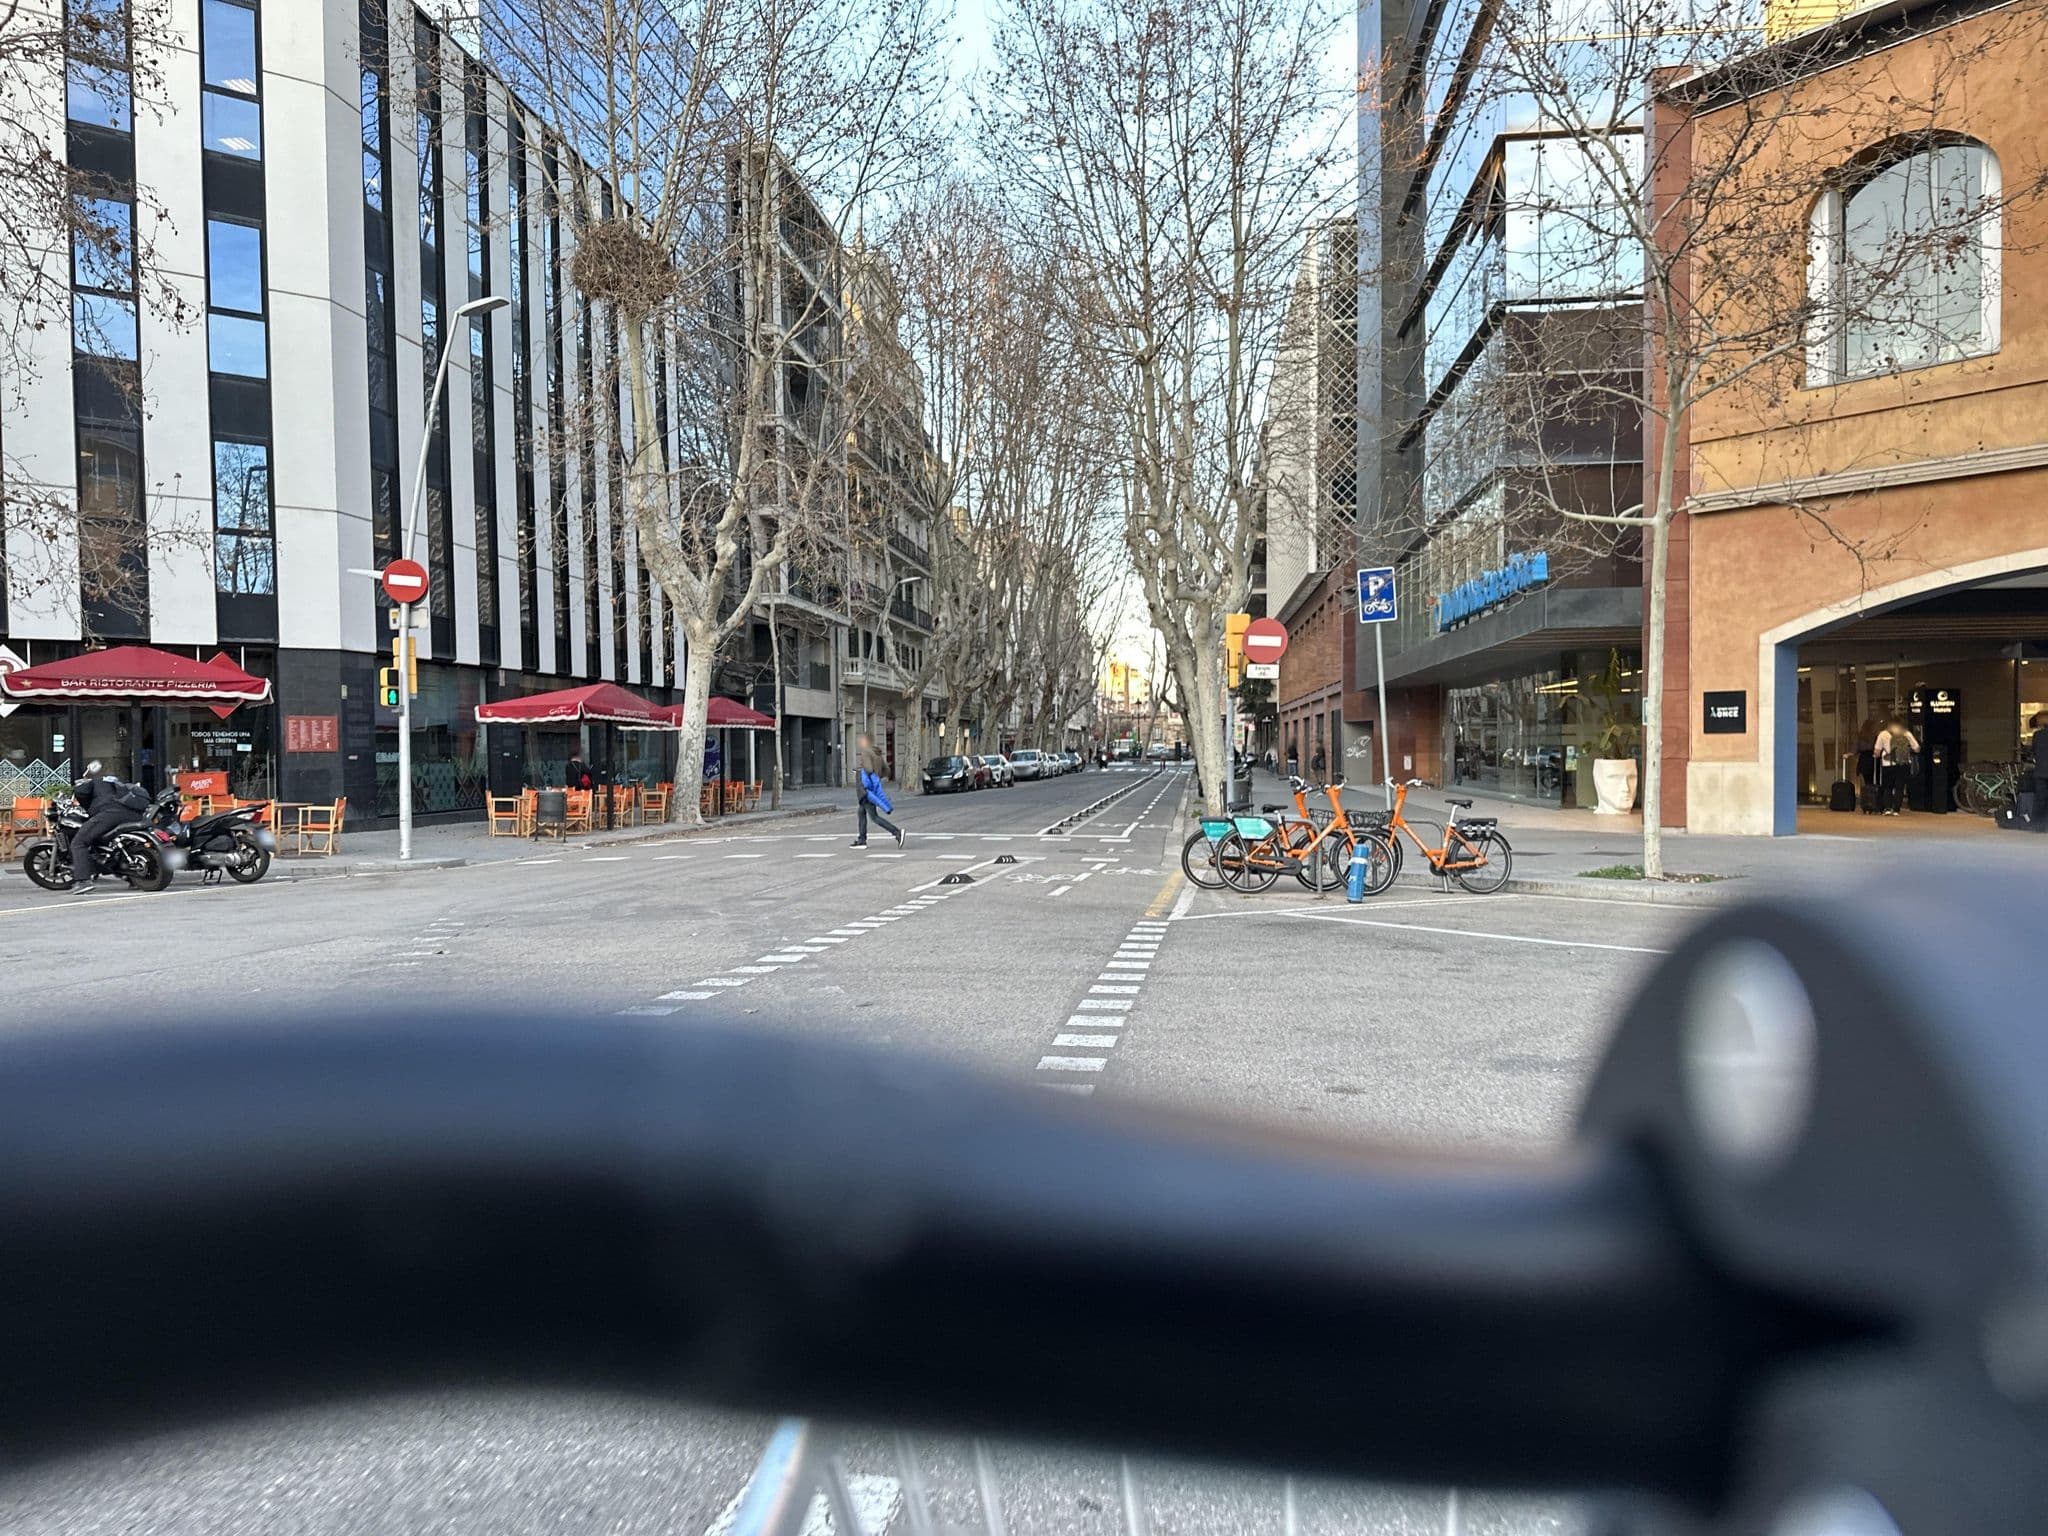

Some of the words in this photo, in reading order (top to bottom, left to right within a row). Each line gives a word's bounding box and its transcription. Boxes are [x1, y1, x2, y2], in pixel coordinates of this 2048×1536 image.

[1368, 575, 1385, 596] P
[61, 679, 87, 687] BAR
[89, 679, 166, 688] RISTORANTE
[167, 680, 217, 689] PIZZERIA
[1717, 710, 1739, 718] ONCE
